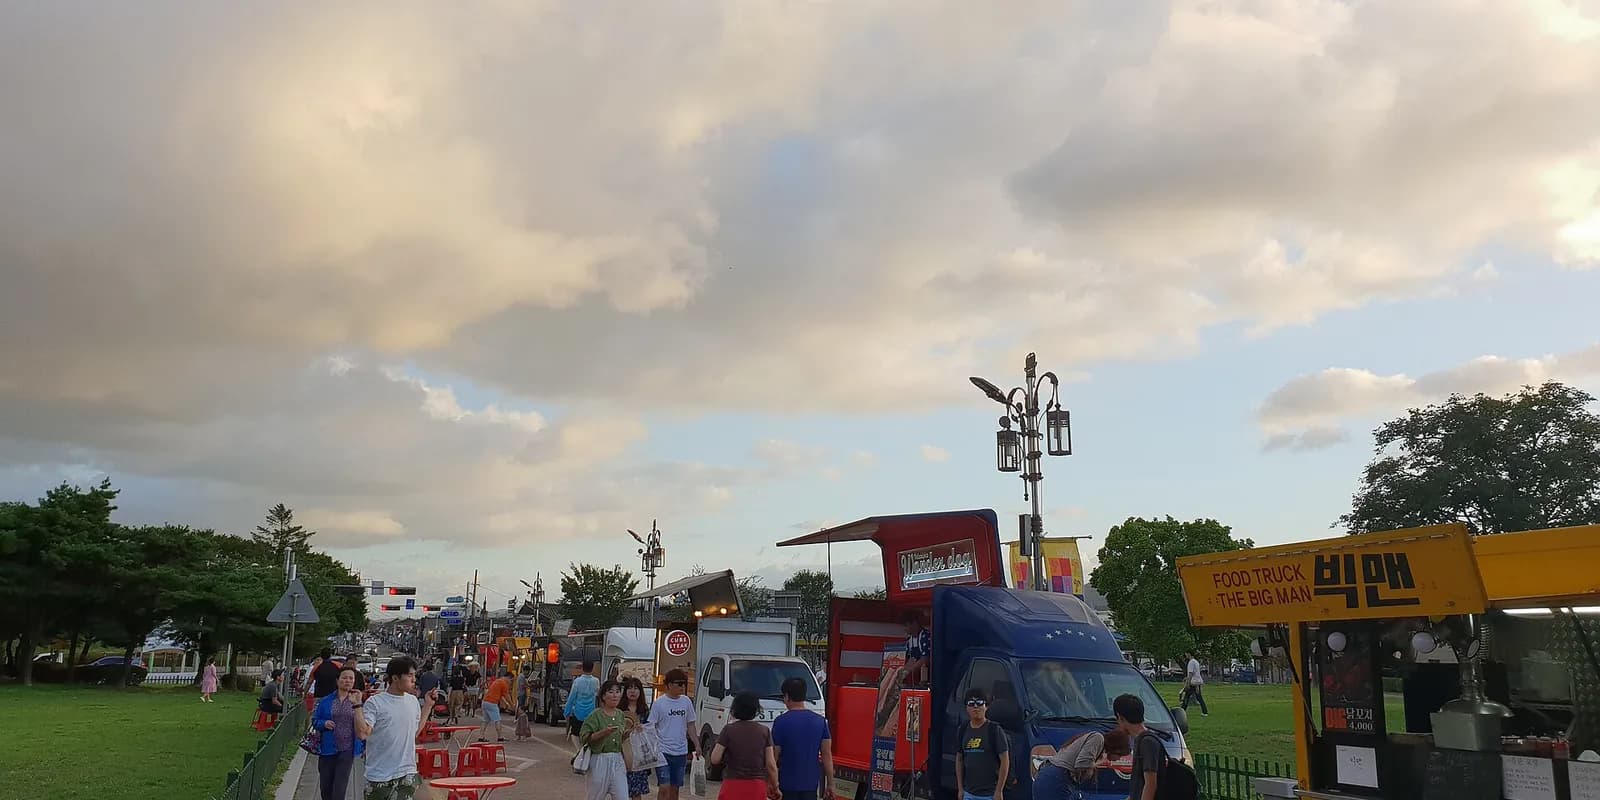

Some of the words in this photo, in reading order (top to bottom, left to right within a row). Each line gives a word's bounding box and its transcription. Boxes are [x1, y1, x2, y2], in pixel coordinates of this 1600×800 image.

[947, 547, 972, 574] dog
[1213, 571, 1251, 589] FOOD
[1252, 564, 1306, 585] TRUCK
[1313, 552, 1420, 609] 빅맨
[1217, 591, 1247, 609] THE
[1250, 588, 1274, 607] BIG
[1276, 585, 1313, 605] MAN
[668, 709, 686, 717] Jeep
[1349, 720, 1373, 731] 4,000
